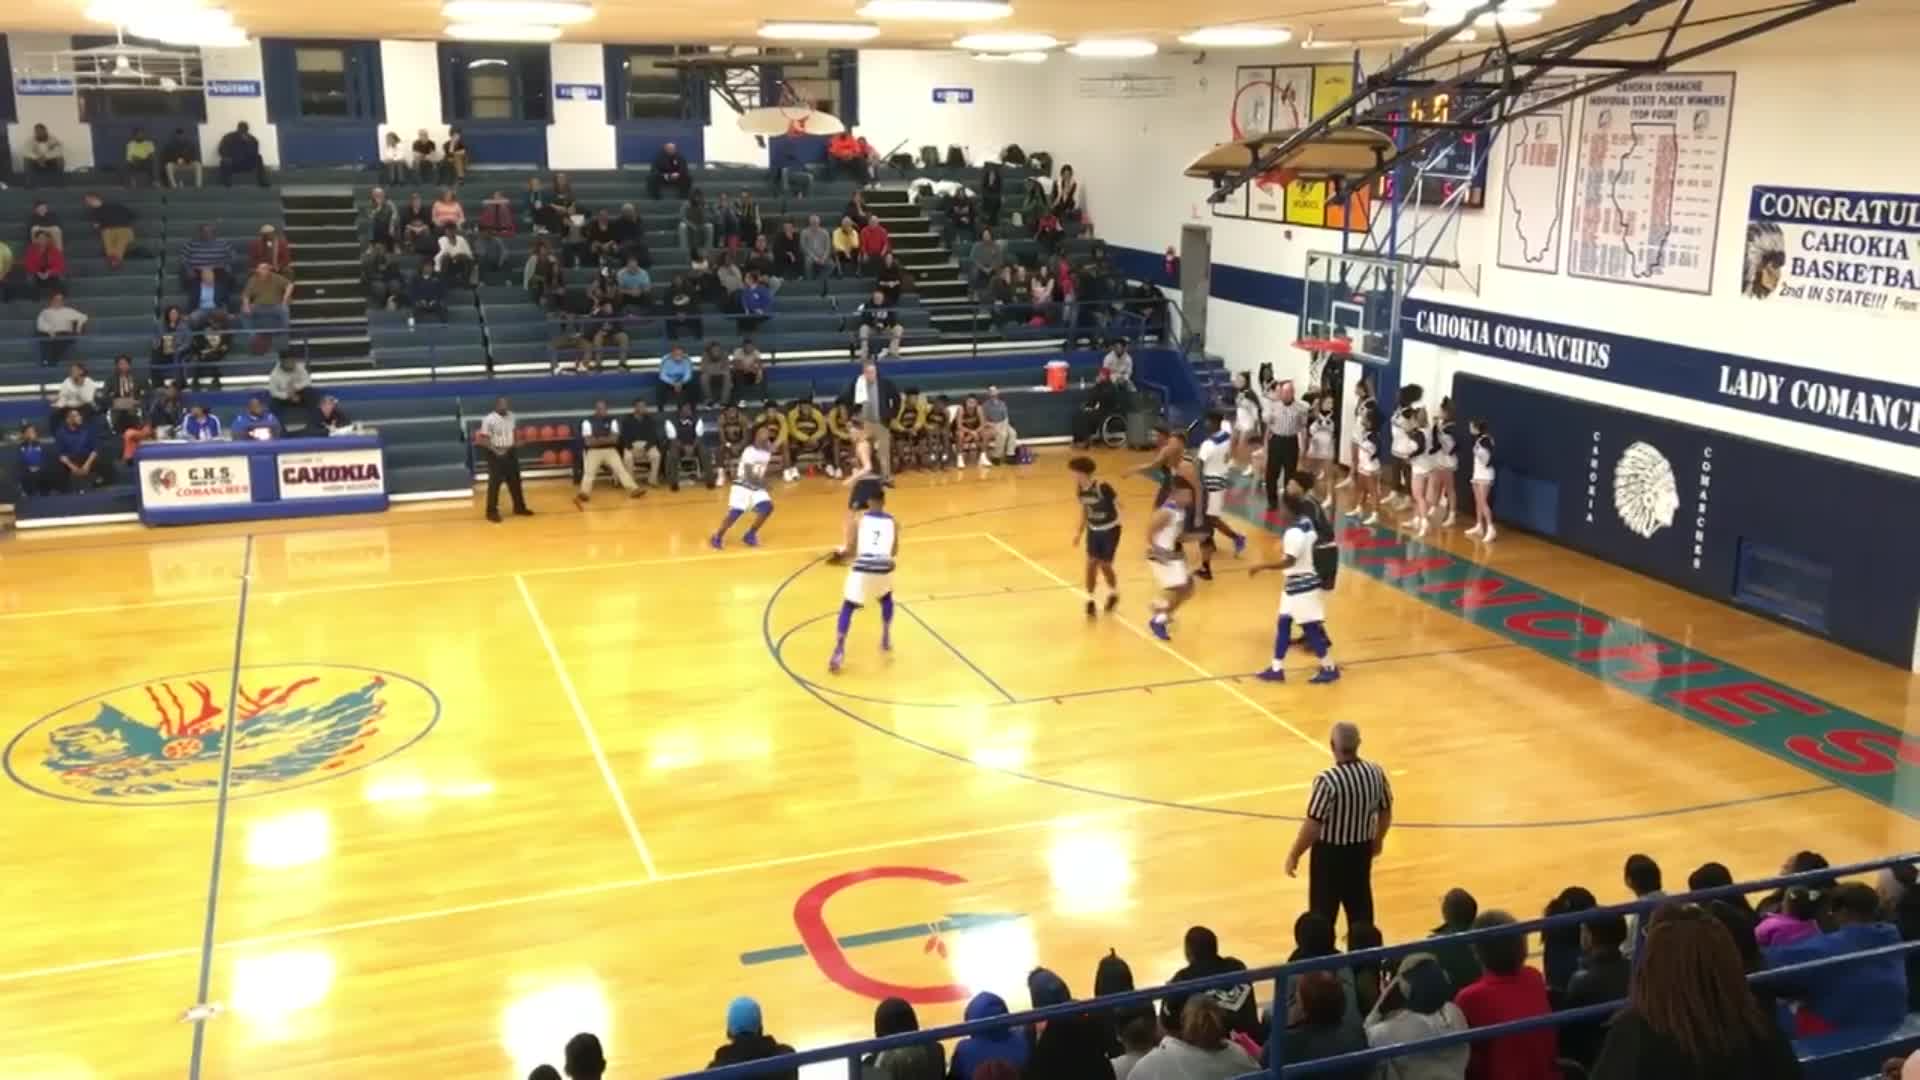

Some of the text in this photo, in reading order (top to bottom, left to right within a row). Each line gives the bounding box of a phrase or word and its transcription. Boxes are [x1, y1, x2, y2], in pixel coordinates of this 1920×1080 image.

[1632, 95, 1657, 106] STATE
[1659, 95, 1684, 106] PLACE
[1687, 95, 1726, 106] WINNERS
[1801, 230, 1909, 260] CAHOKIA
[1791, 257, 1920, 291] BASKETBA
[1779, 281, 1805, 299] 2nd
[1808, 285, 1823, 301] IN
[1825, 287, 1888, 309] STATE!!!
[1416, 310, 1610, 369] CAHOKIA COMANCHES
[1718, 365, 1785, 405] LADY
[283, 464, 380, 485] CAHOKIA
[1586, 431, 1601, 523] CAHOKIA
[1693, 446, 1712, 569] COMANCHES
